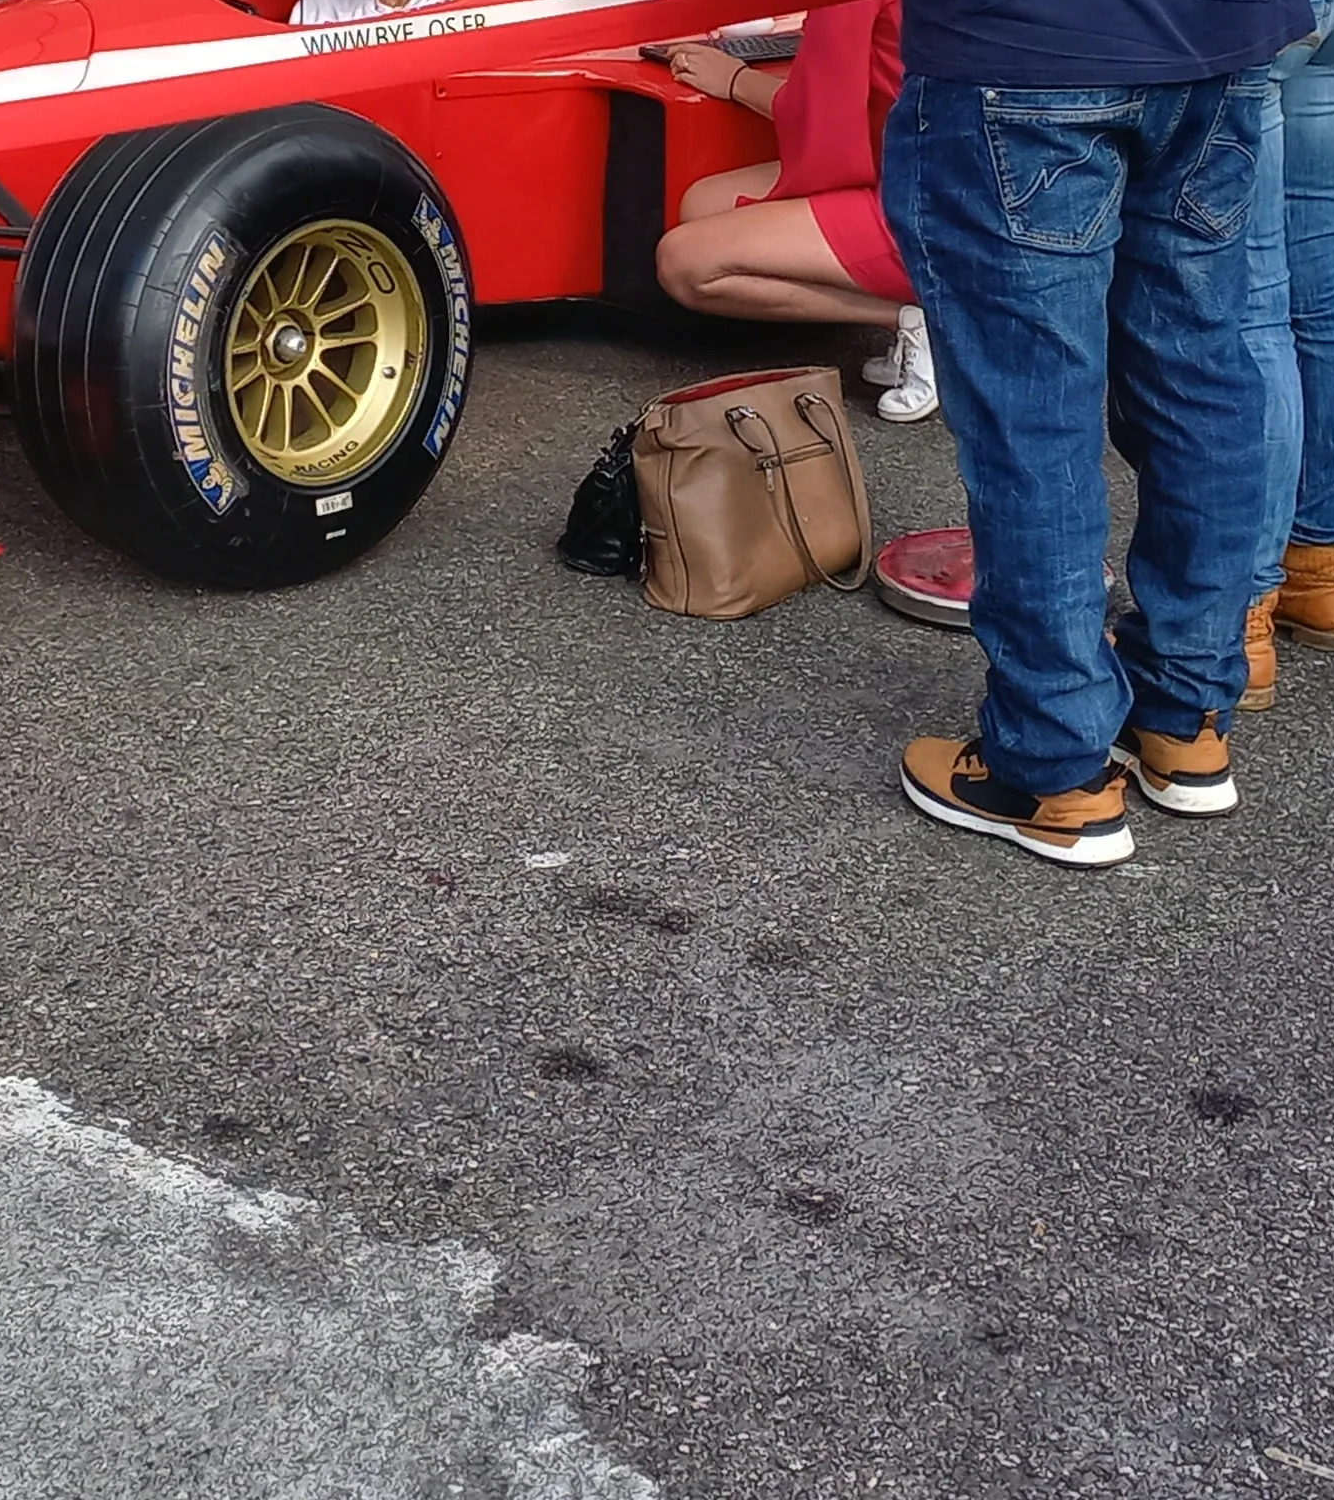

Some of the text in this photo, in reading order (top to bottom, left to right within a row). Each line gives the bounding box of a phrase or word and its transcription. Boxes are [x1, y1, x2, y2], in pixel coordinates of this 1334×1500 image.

[171, 241, 227, 462] MICHELIN
[431, 244, 470, 453] MICHELIN
[293, 439, 360, 473] RACING
